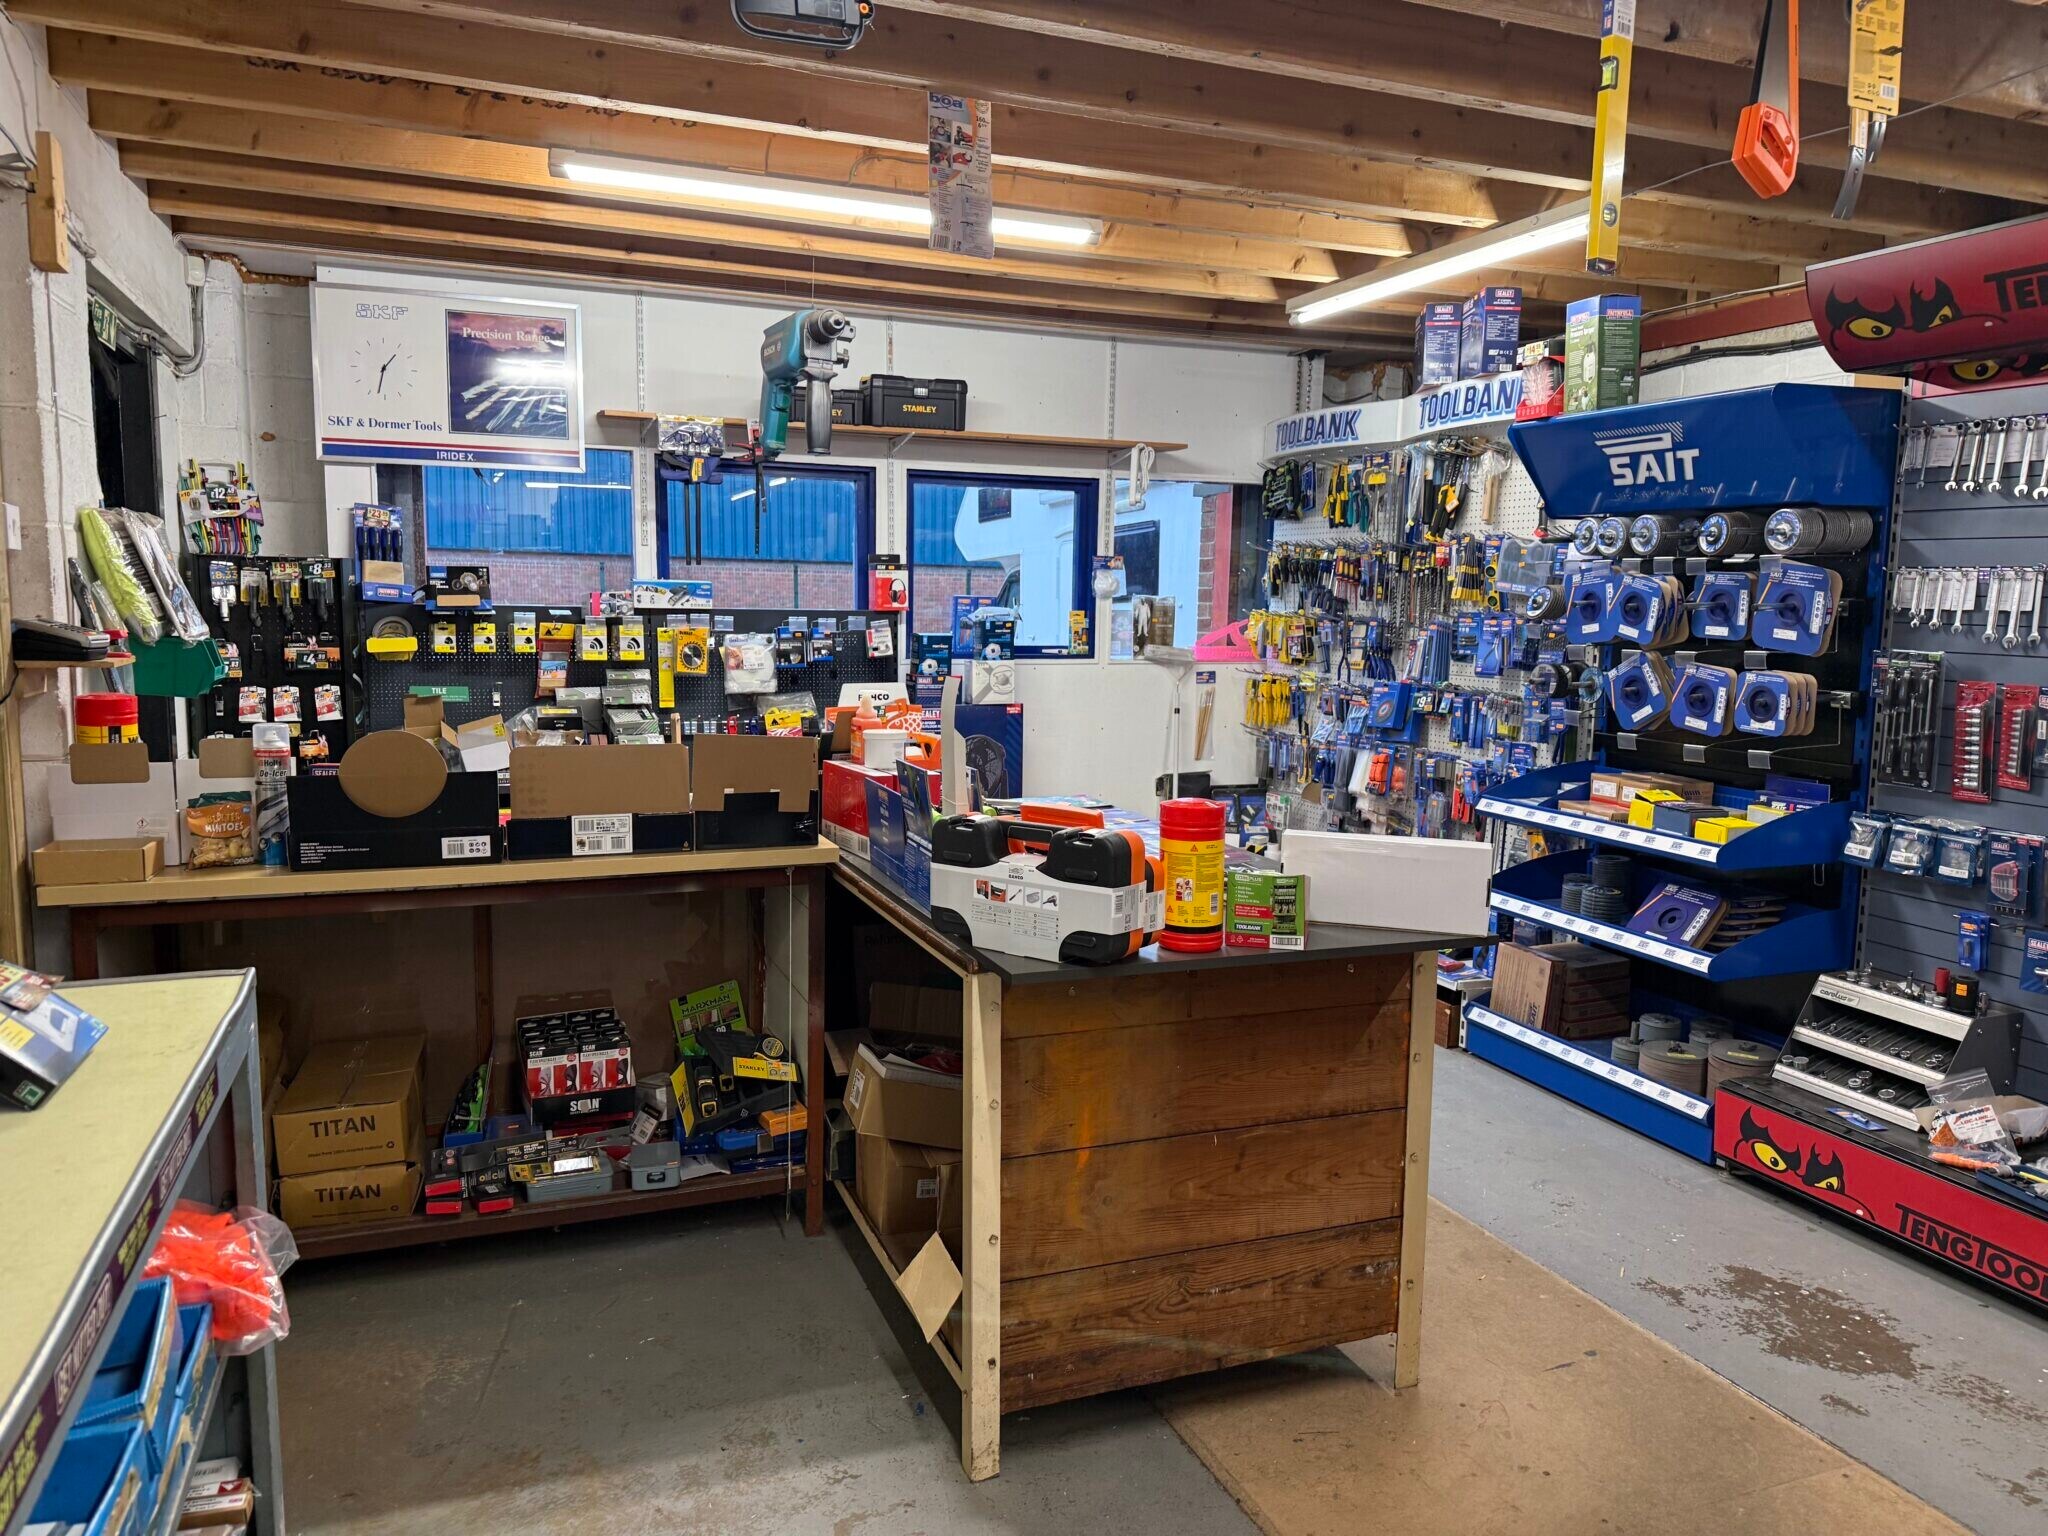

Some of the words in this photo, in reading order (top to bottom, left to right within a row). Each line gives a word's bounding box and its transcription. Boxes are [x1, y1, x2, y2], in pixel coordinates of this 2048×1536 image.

[355, 303, 409, 320] SKF
[462, 327, 512, 341] Precision
[516, 331, 550, 343] Range
[902, 404, 937, 414] STANLEY
[1418, 375, 1523, 430] TOOLBAN
[328, 416, 354, 427] SKF
[356, 418, 365, 428] &
[369, 418, 411, 430] Dormer
[413, 420, 443, 432] Tools
[1275, 409, 1362, 453] TOOLBANK
[436, 451, 475, 461] IRIDEX
[1608, 448, 1700, 487] SAIT
[204, 823, 244, 832] MINTOES
[1992, 842, 2009, 850] SEALEY
[1236, 923, 1261, 931] TOOLBANK
[682, 993, 730, 1014] MARXMAN
[738, 1064, 765, 1072] STANLEY
[570, 1099, 600, 1112] SCN
[309, 1115, 376, 1138] TITAN
[314, 1184, 381, 1203] TITAN
